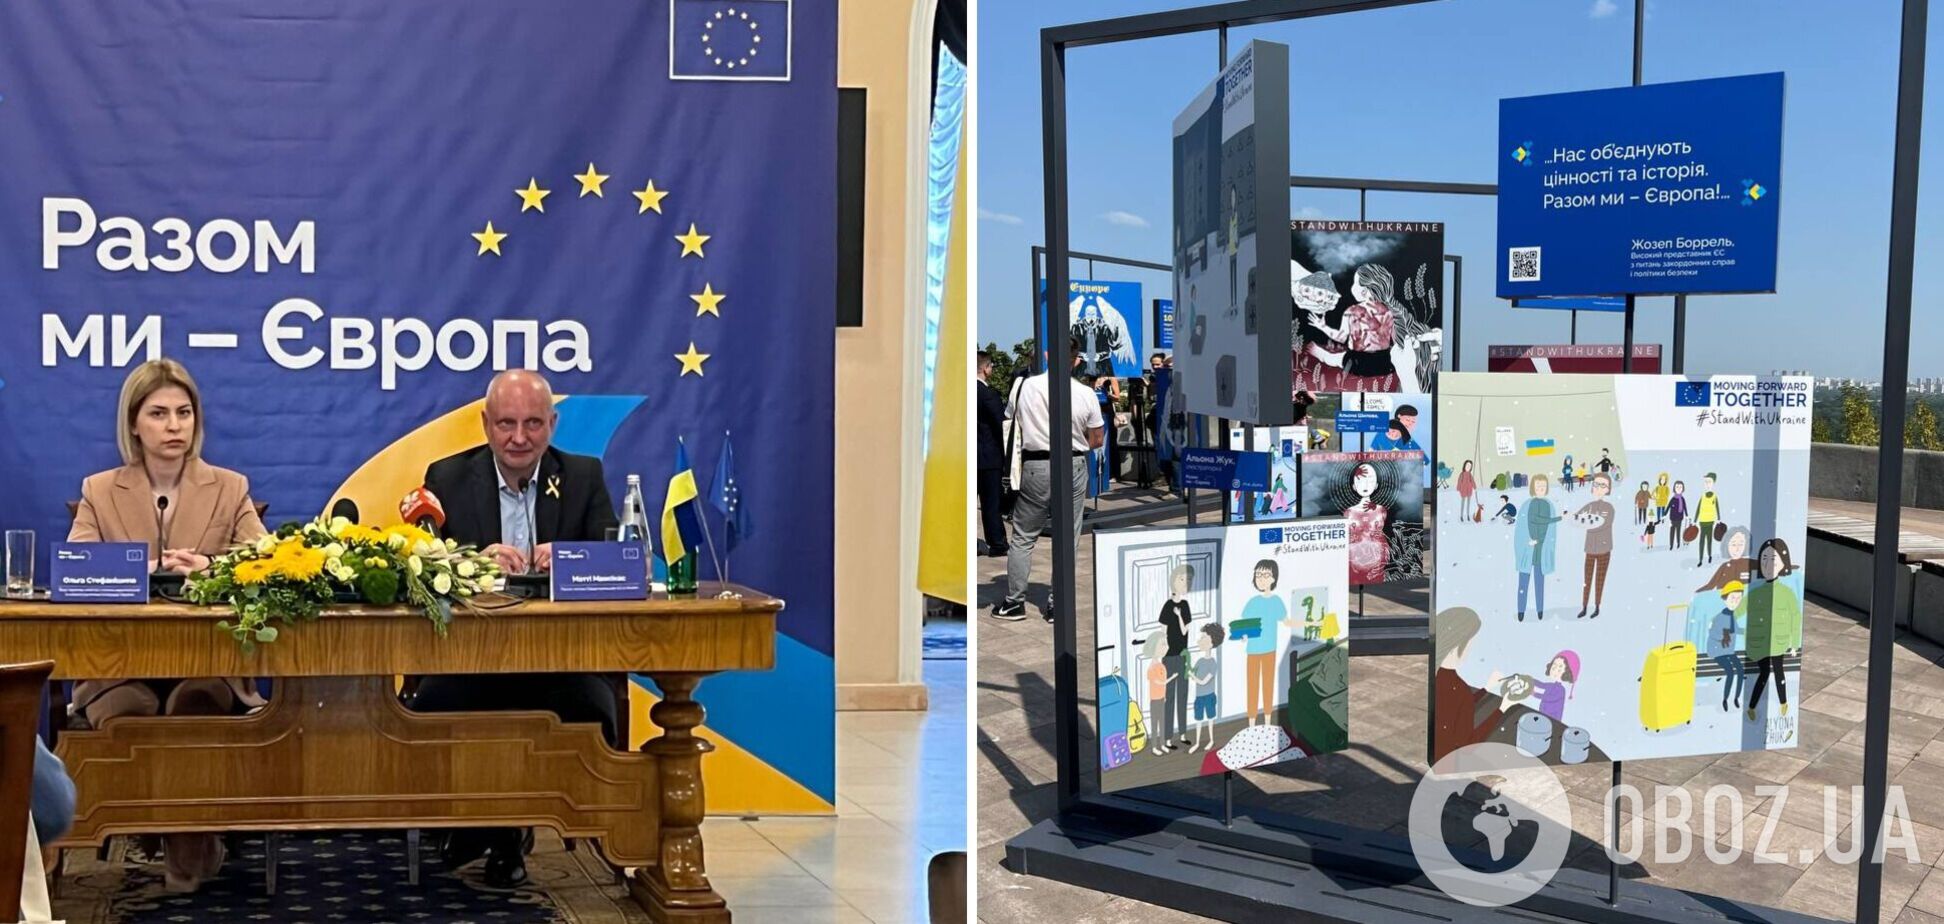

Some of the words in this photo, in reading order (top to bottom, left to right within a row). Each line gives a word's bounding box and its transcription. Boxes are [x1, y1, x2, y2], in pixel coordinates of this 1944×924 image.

[1543, 167, 1613, 189] цінності
[1617, 169, 1637, 181] та
[1642, 161, 1709, 182] історія.
[1543, 194, 1595, 209] Разом
[1600, 193, 1624, 206] ми
[41, 197, 316, 274] Разом
[1631, 239, 1673, 250] Жозеп
[1630, 251, 1662, 259] Високий
[1663, 250, 1711, 259] представник
[1633, 269, 1666, 277] політики
[1667, 268, 1698, 276] безпеки
[41, 313, 162, 367] ми
[261, 298, 593, 391] Європа
[1491, 346, 1654, 356] #STANDWITHUKRANE
[1713, 381, 1755, 391] MOVING
[1757, 382, 1808, 391] FORWARD
[1713, 392, 1807, 407] TOGETHER
[1186, 454, 1215, 463] Альона
[1284, 529, 1346, 542] TOGETHER
